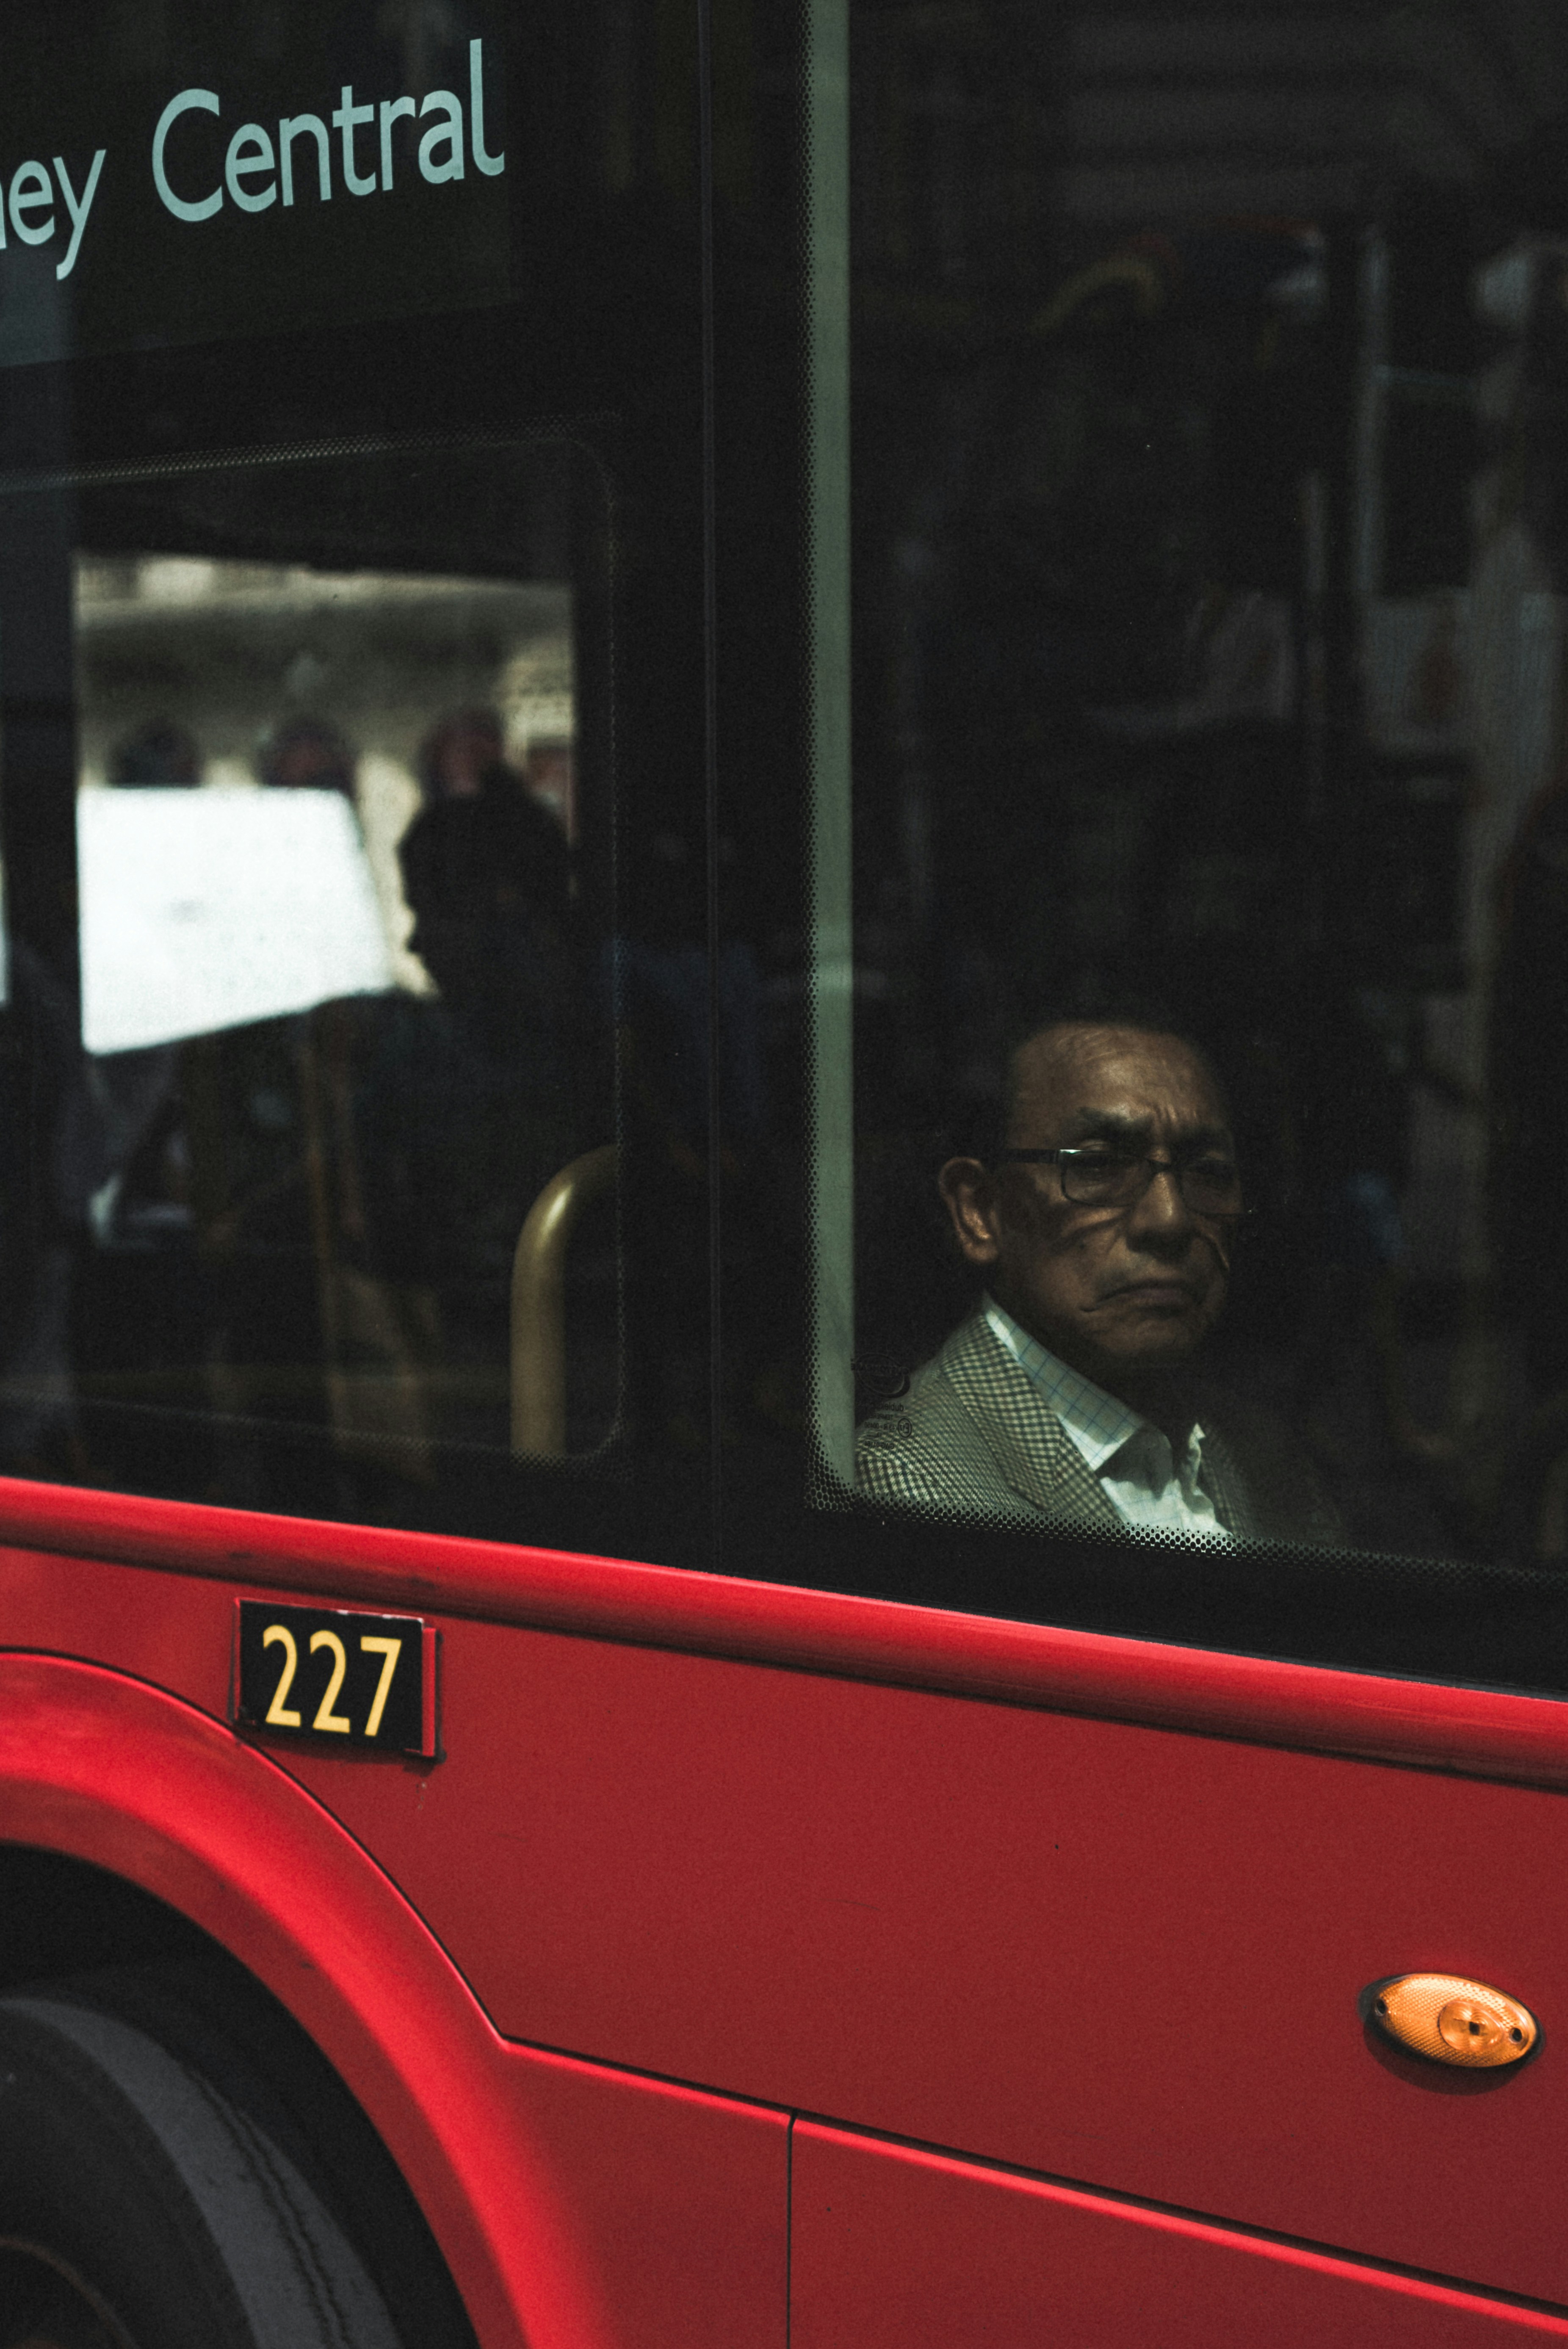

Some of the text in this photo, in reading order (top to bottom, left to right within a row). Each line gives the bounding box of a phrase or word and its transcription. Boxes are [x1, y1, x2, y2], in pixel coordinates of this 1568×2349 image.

[0, 38, 505, 280] ey Central
[263, 1625, 402, 1737] 227
